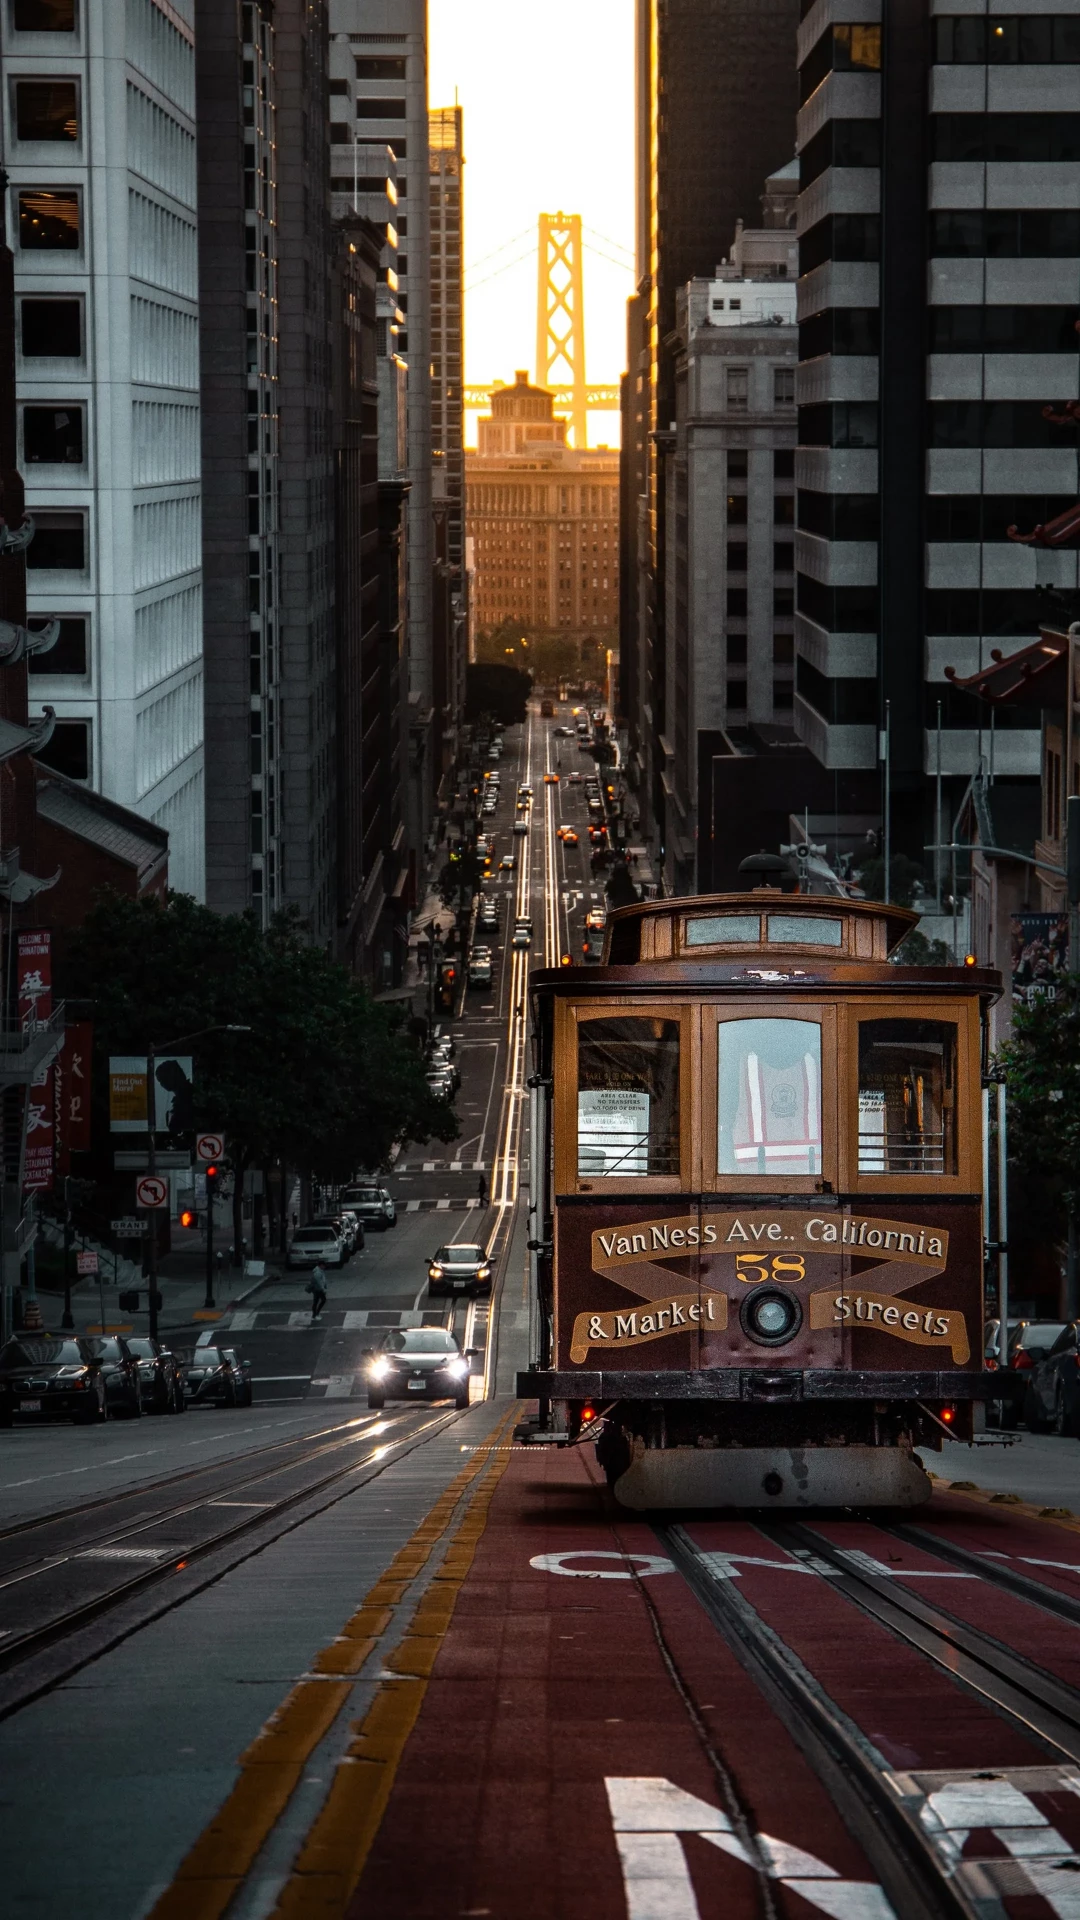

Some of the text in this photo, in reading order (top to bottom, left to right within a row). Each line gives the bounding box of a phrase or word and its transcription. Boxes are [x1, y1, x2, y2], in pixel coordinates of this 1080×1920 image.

[18, 933, 51, 945] WELCOME TO
[18, 945, 49, 956] CHINATOWN
[112, 1077, 143, 1085] Find Out
[24, 1146, 53, 1157] THAY HOUSE
[23, 1157, 53, 1169] STAURANT
[22, 1169, 47, 1180] OCKTAILS
[598, 1232, 647, 1258] Van
[649, 1222, 717, 1250] Ness
[805, 1218, 943, 1257] California
[735, 1253, 806, 1283] 58
[588, 1295, 950, 1341] & Market Streets
